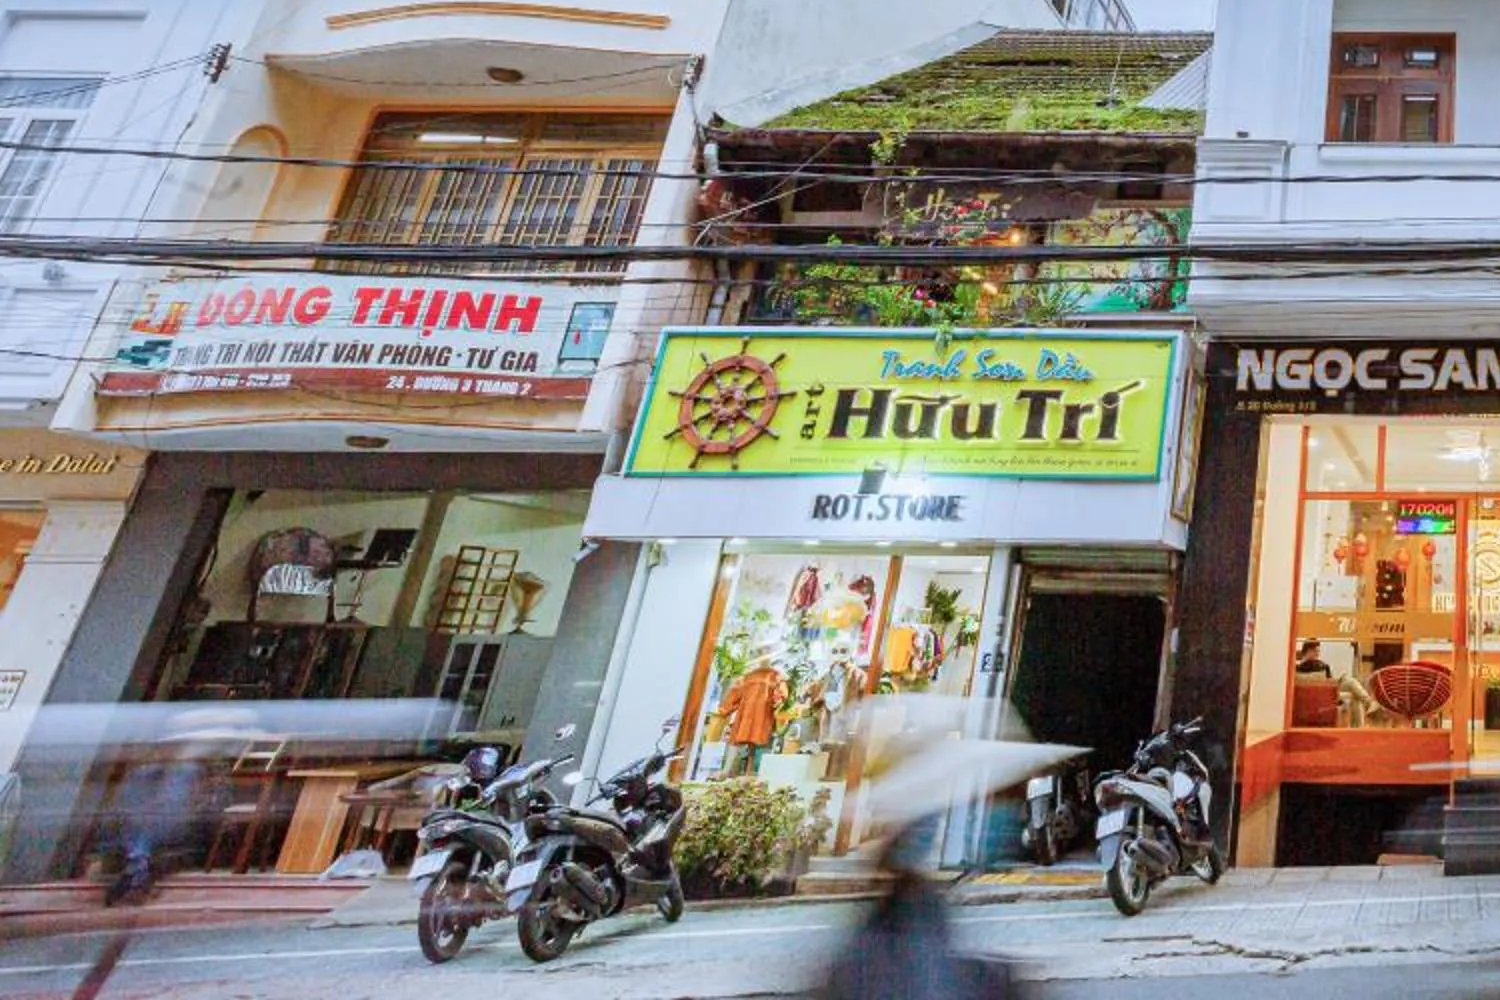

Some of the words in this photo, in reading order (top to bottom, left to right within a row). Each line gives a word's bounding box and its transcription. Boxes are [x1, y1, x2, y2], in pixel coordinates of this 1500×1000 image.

[351, 286, 543, 338] THỊNH
[377, 342, 452, 367] PHÒNG
[466, 347, 498, 370] TƯ
[500, 350, 538, 373] GIA
[880, 348, 966, 381] Tranh
[1235, 348, 1391, 397] NGỌC
[520, 382, 532, 396] 2
[799, 383, 825, 440] art
[826, 386, 1000, 441] Hữu
[1014, 379, 1145, 441] Trí
[16, 453, 43, 474] in
